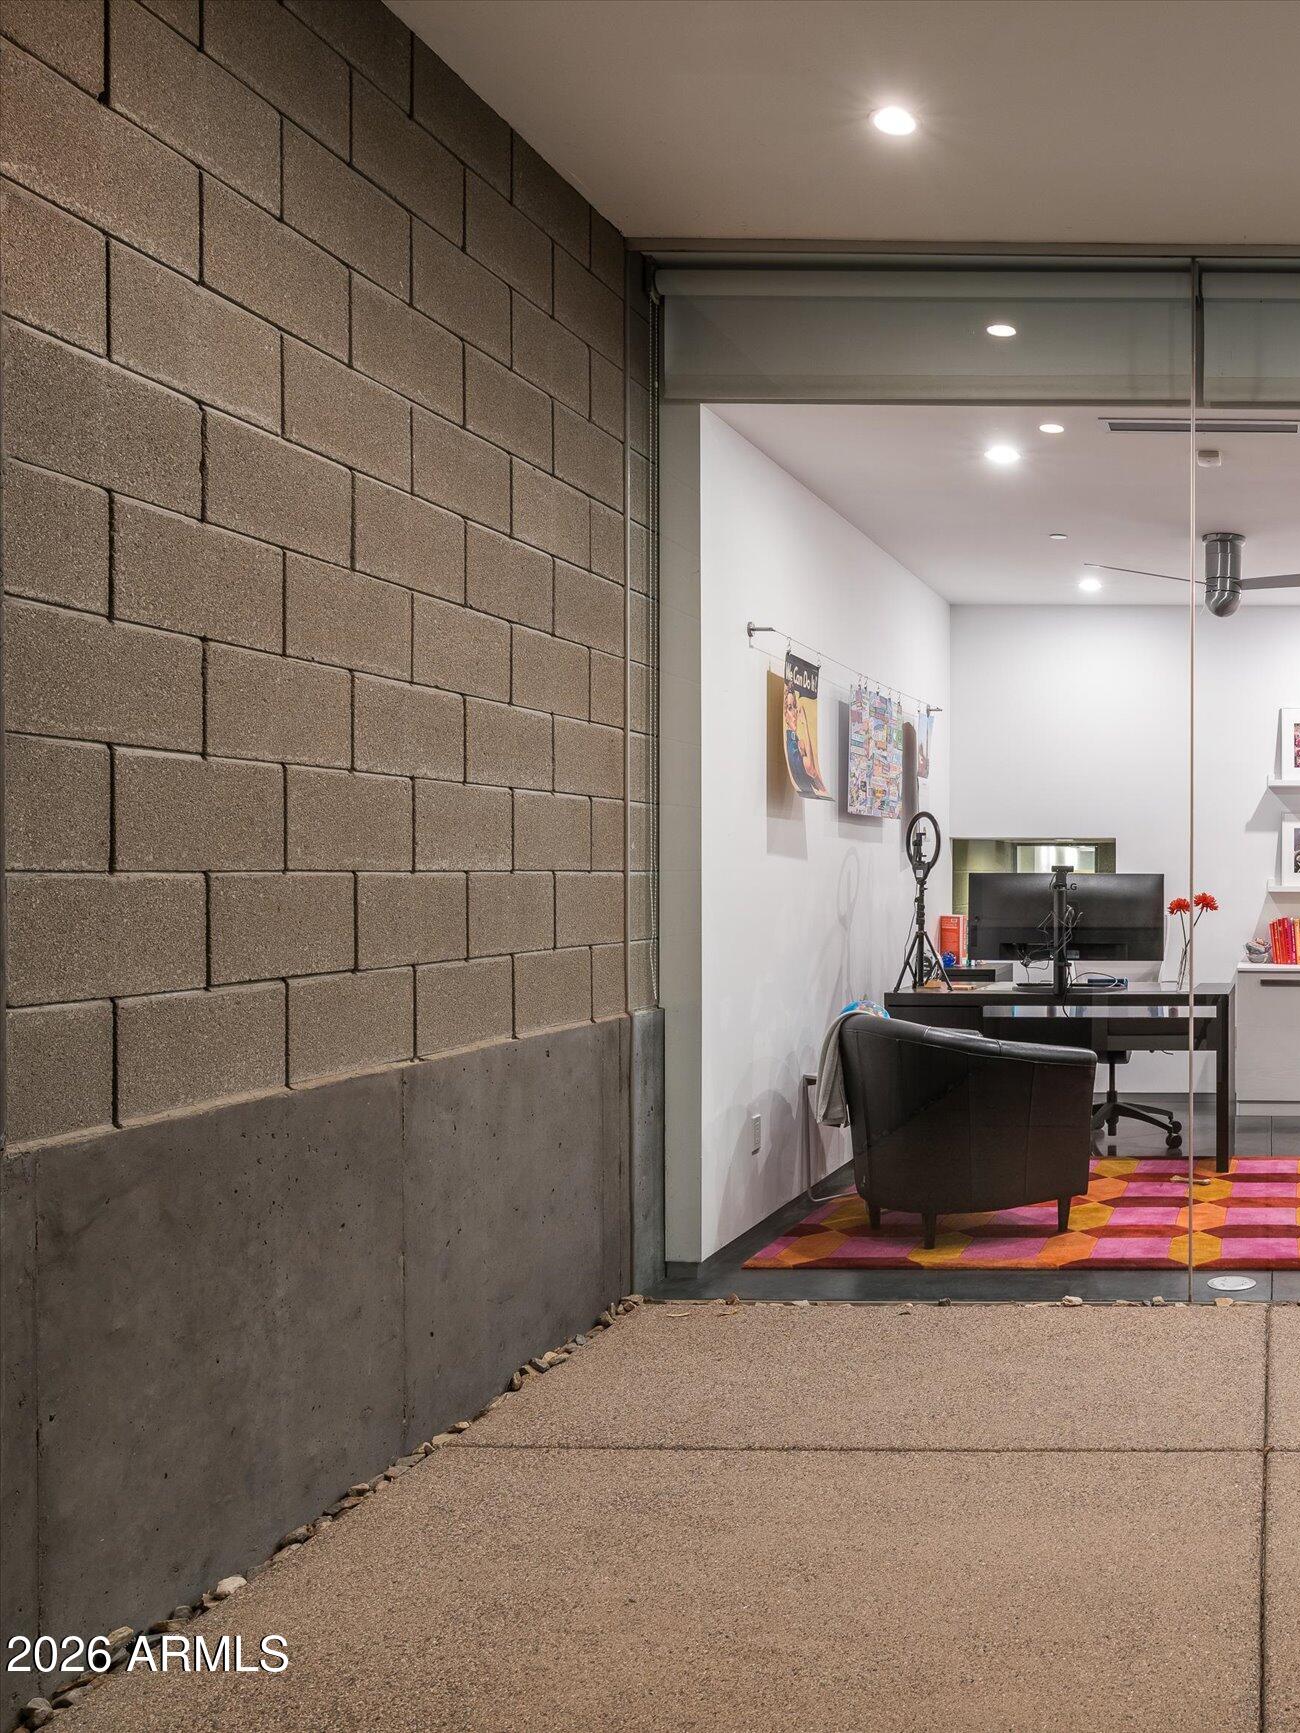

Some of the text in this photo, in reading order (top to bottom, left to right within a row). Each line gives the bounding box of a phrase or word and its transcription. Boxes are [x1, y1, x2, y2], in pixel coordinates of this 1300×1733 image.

[785, 661, 793, 681] We
[793, 666, 803, 687] Can
[803, 670, 811, 690] Do
